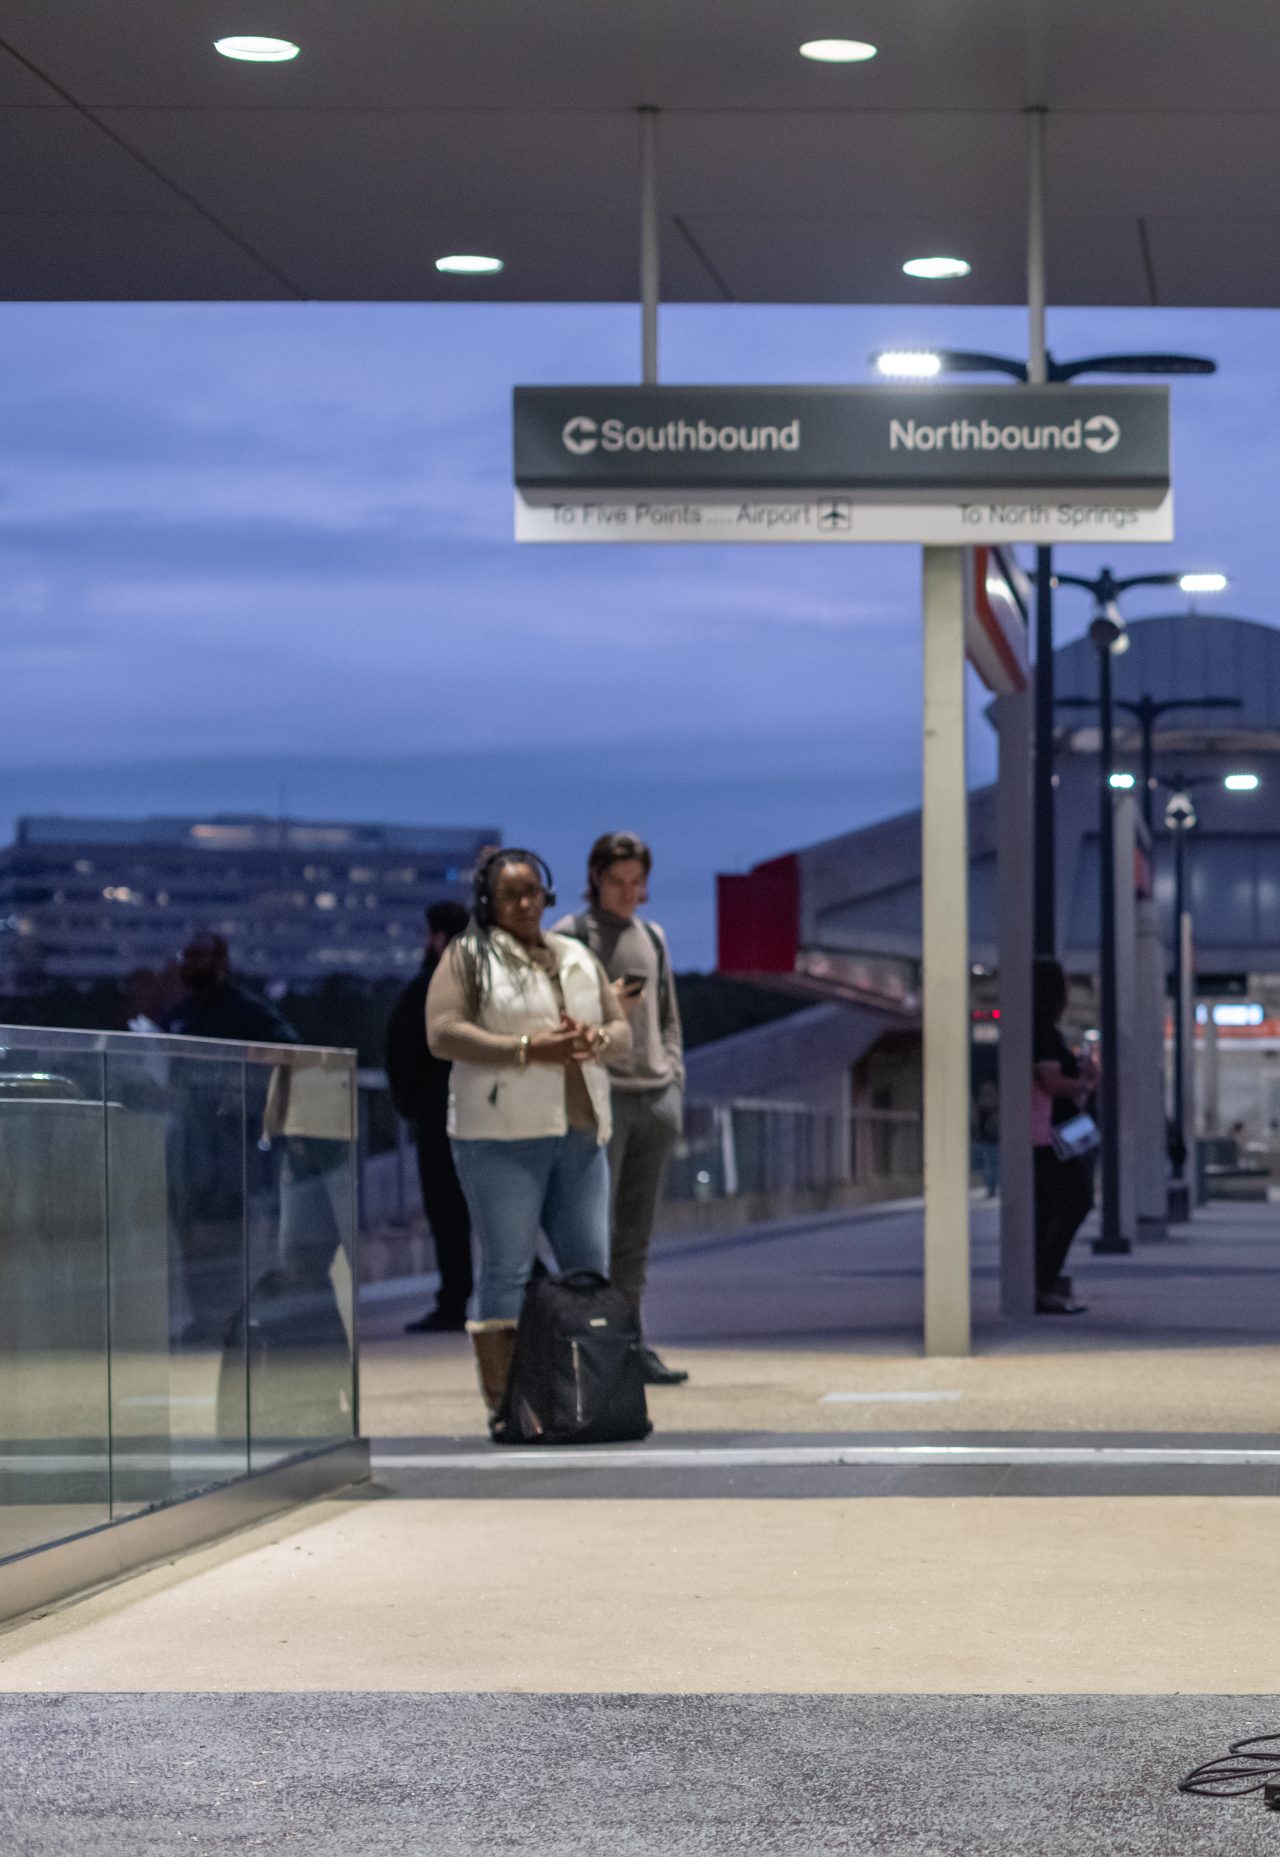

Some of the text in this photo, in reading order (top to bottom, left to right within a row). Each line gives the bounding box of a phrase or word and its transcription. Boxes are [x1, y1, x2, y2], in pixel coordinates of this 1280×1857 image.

[601, 418, 799, 450] Southbound
[889, 419, 1081, 450] Northbound
[552, 502, 811, 527] To Five Points Airport
[959, 503, 1138, 528] To North Springs
